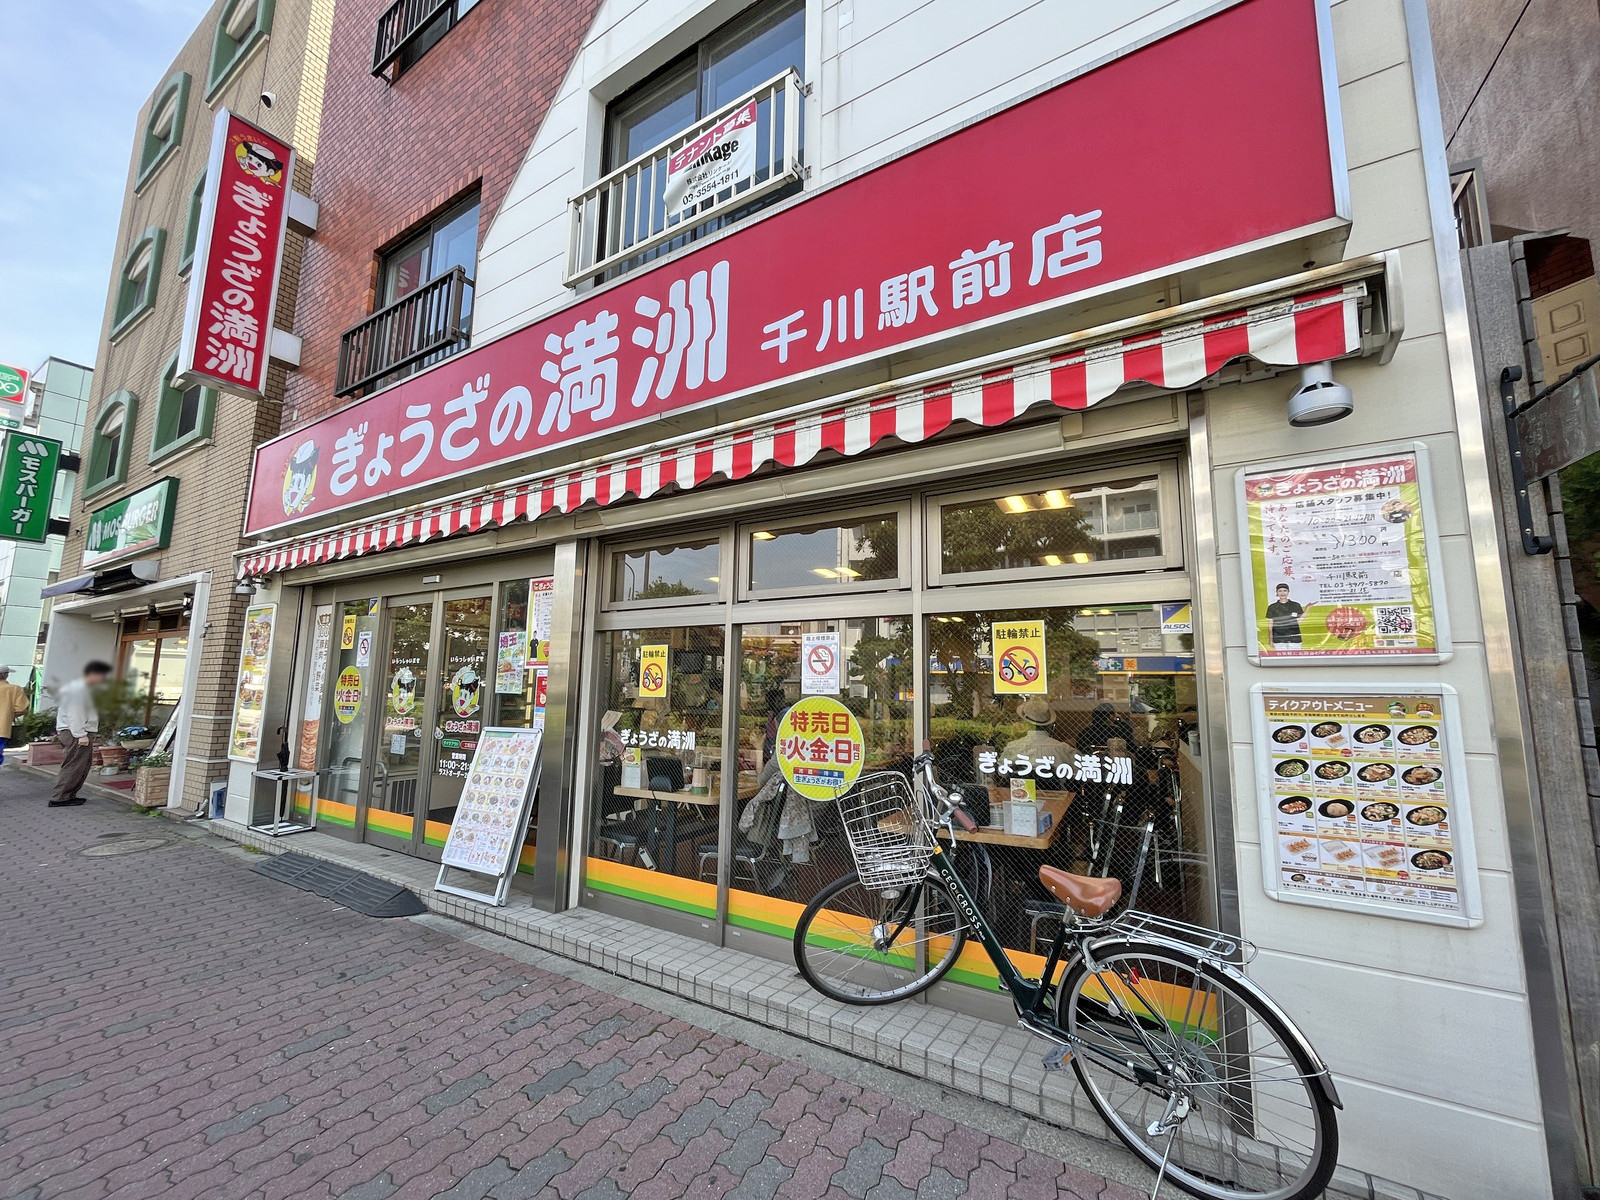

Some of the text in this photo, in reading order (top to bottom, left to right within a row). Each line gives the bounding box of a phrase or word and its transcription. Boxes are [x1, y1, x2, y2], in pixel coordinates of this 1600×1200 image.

[675, 108, 751, 170] テナント募集
[204, 180, 273, 382] ぎょうざの満洲
[330, 209, 1102, 496] ぎょうざの満洲 千川駅前店
[11, 456, 40, 534] モスバーガー
[1275, 464, 1406, 497] ぎょうざの満洲
[995, 628, 1042, 640] 駐輪禁止
[790, 710, 850, 734] 特売日
[1268, 700, 1374, 711] テイクアウトメニュー
[620, 728, 696, 751] ぎょうざの満洲
[978, 751, 1133, 785] ぎょうざの満洲
